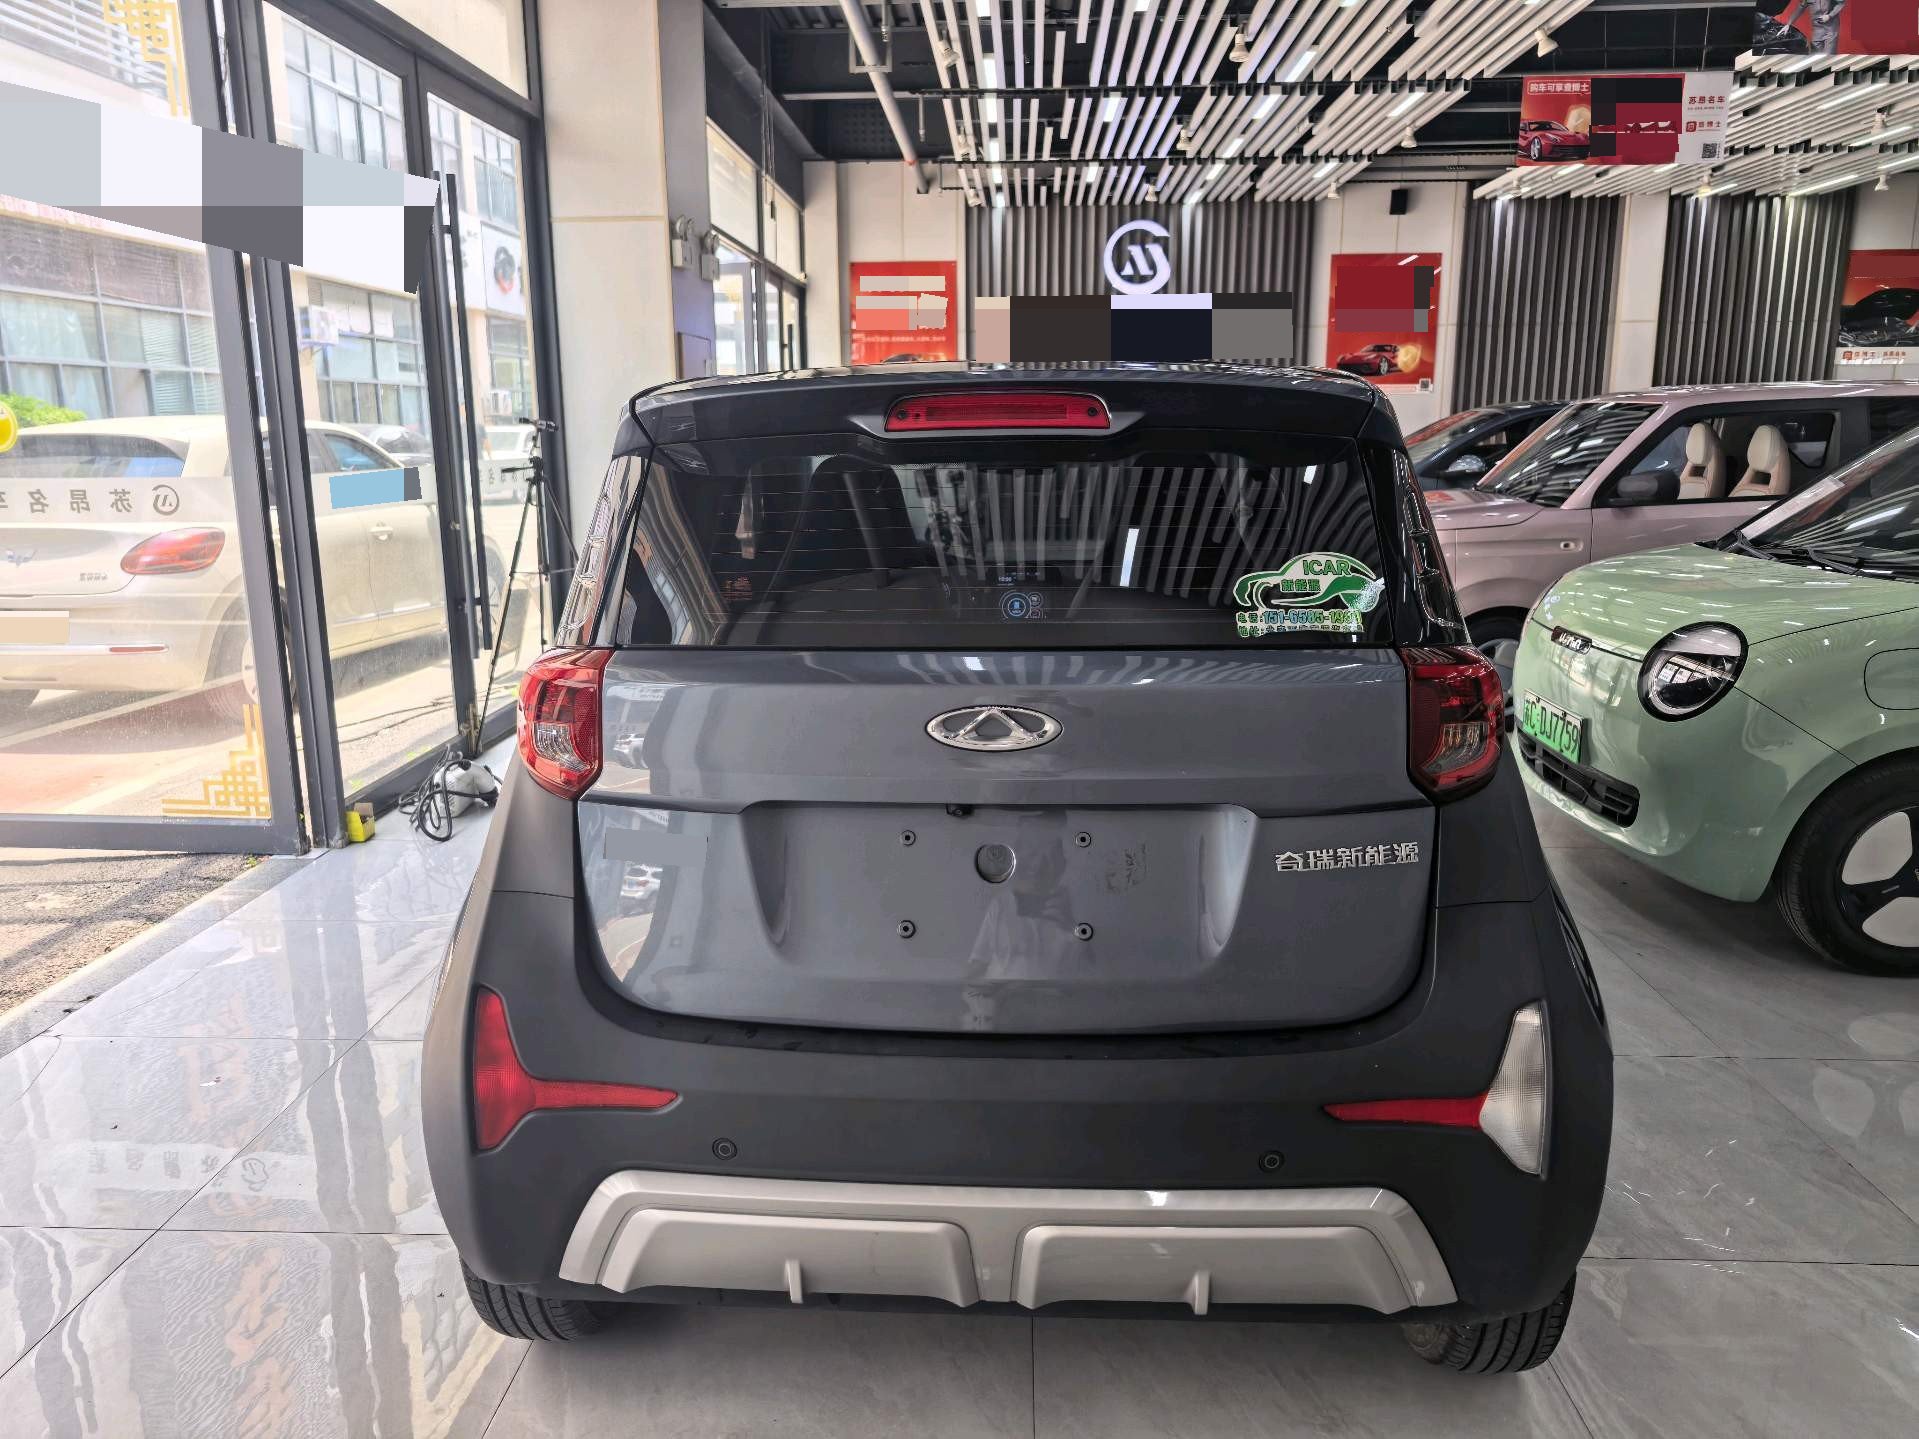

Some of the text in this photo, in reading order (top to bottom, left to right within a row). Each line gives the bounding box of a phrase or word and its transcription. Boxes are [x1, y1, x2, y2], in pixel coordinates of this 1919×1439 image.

[1302, 559, 1352, 576] ICAR
[1280, 579, 1321, 592] 新能源
[1275, 841, 1419, 872] 奇瑞新能源
